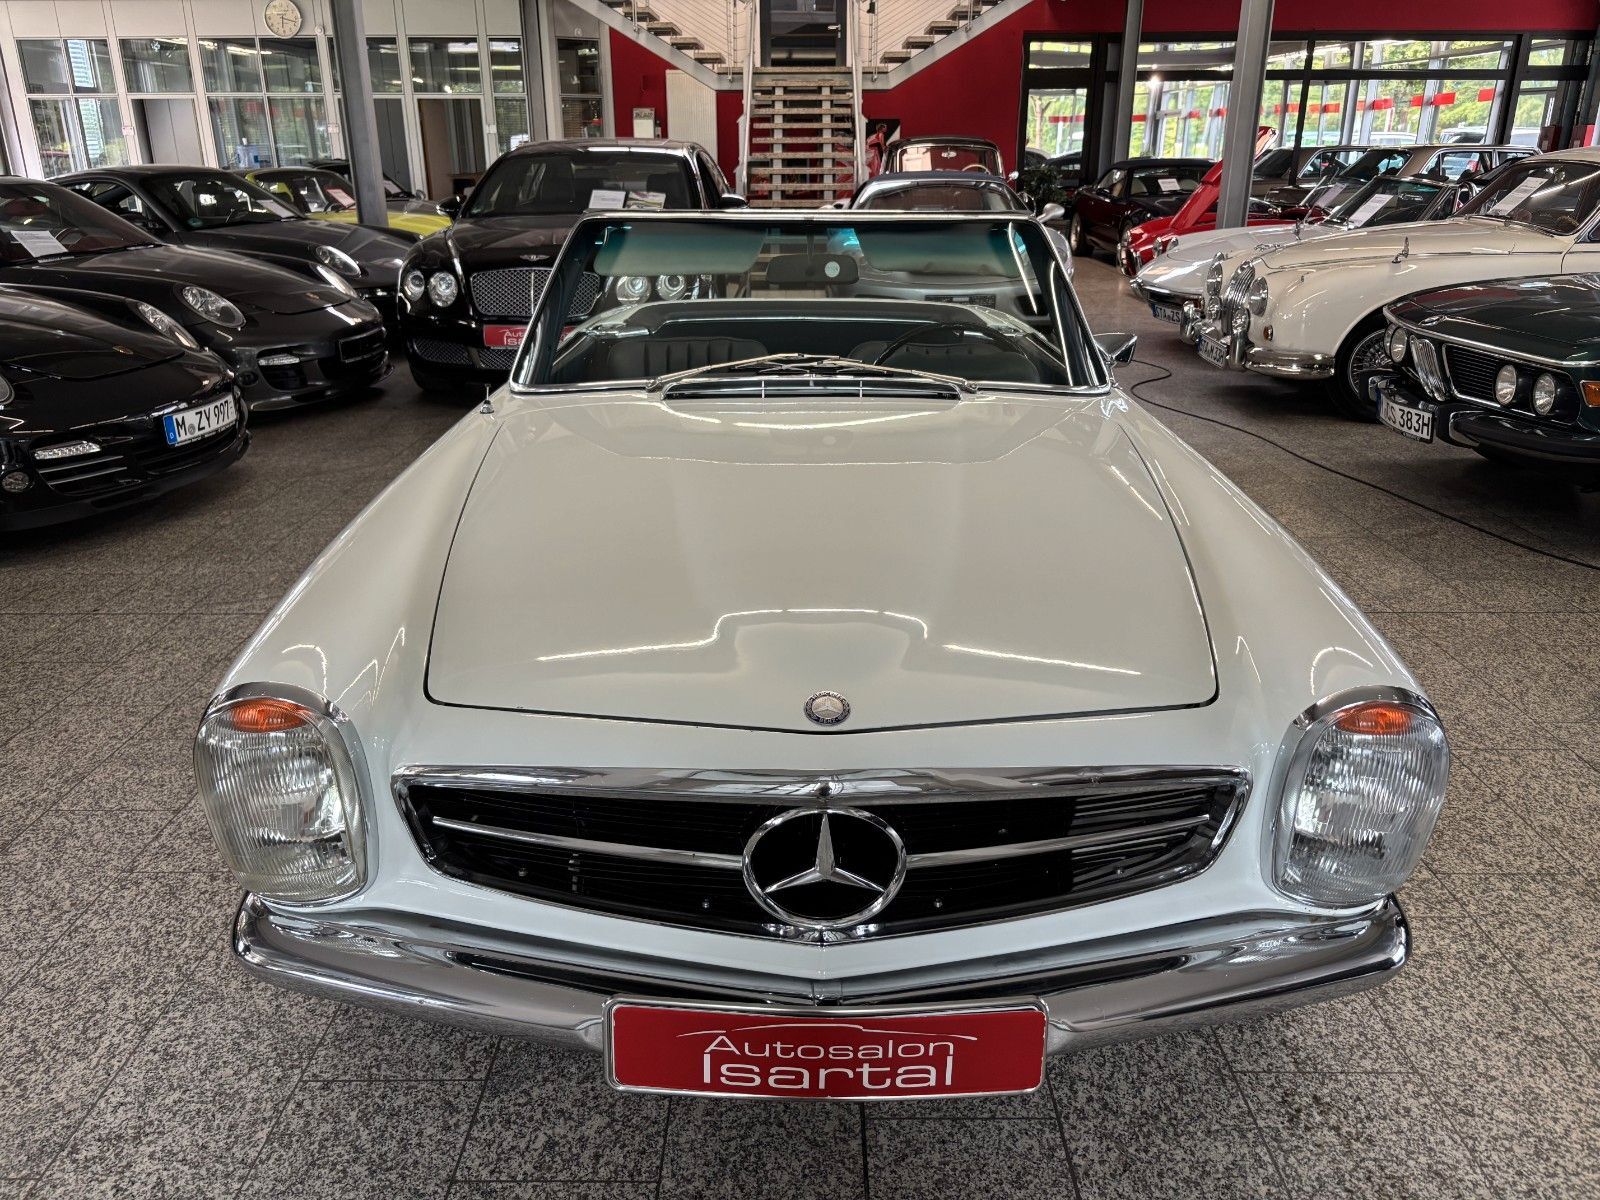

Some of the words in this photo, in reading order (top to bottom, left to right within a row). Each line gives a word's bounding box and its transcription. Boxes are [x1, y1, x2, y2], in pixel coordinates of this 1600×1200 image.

[175, 416, 187, 437] M
[195, 407, 211, 432] ZY
[214, 400, 229, 425] 997
[1399, 408, 1431, 436] 383H
[704, 1035, 954, 1060] Autosalon
[703, 1054, 954, 1090] Isartal
